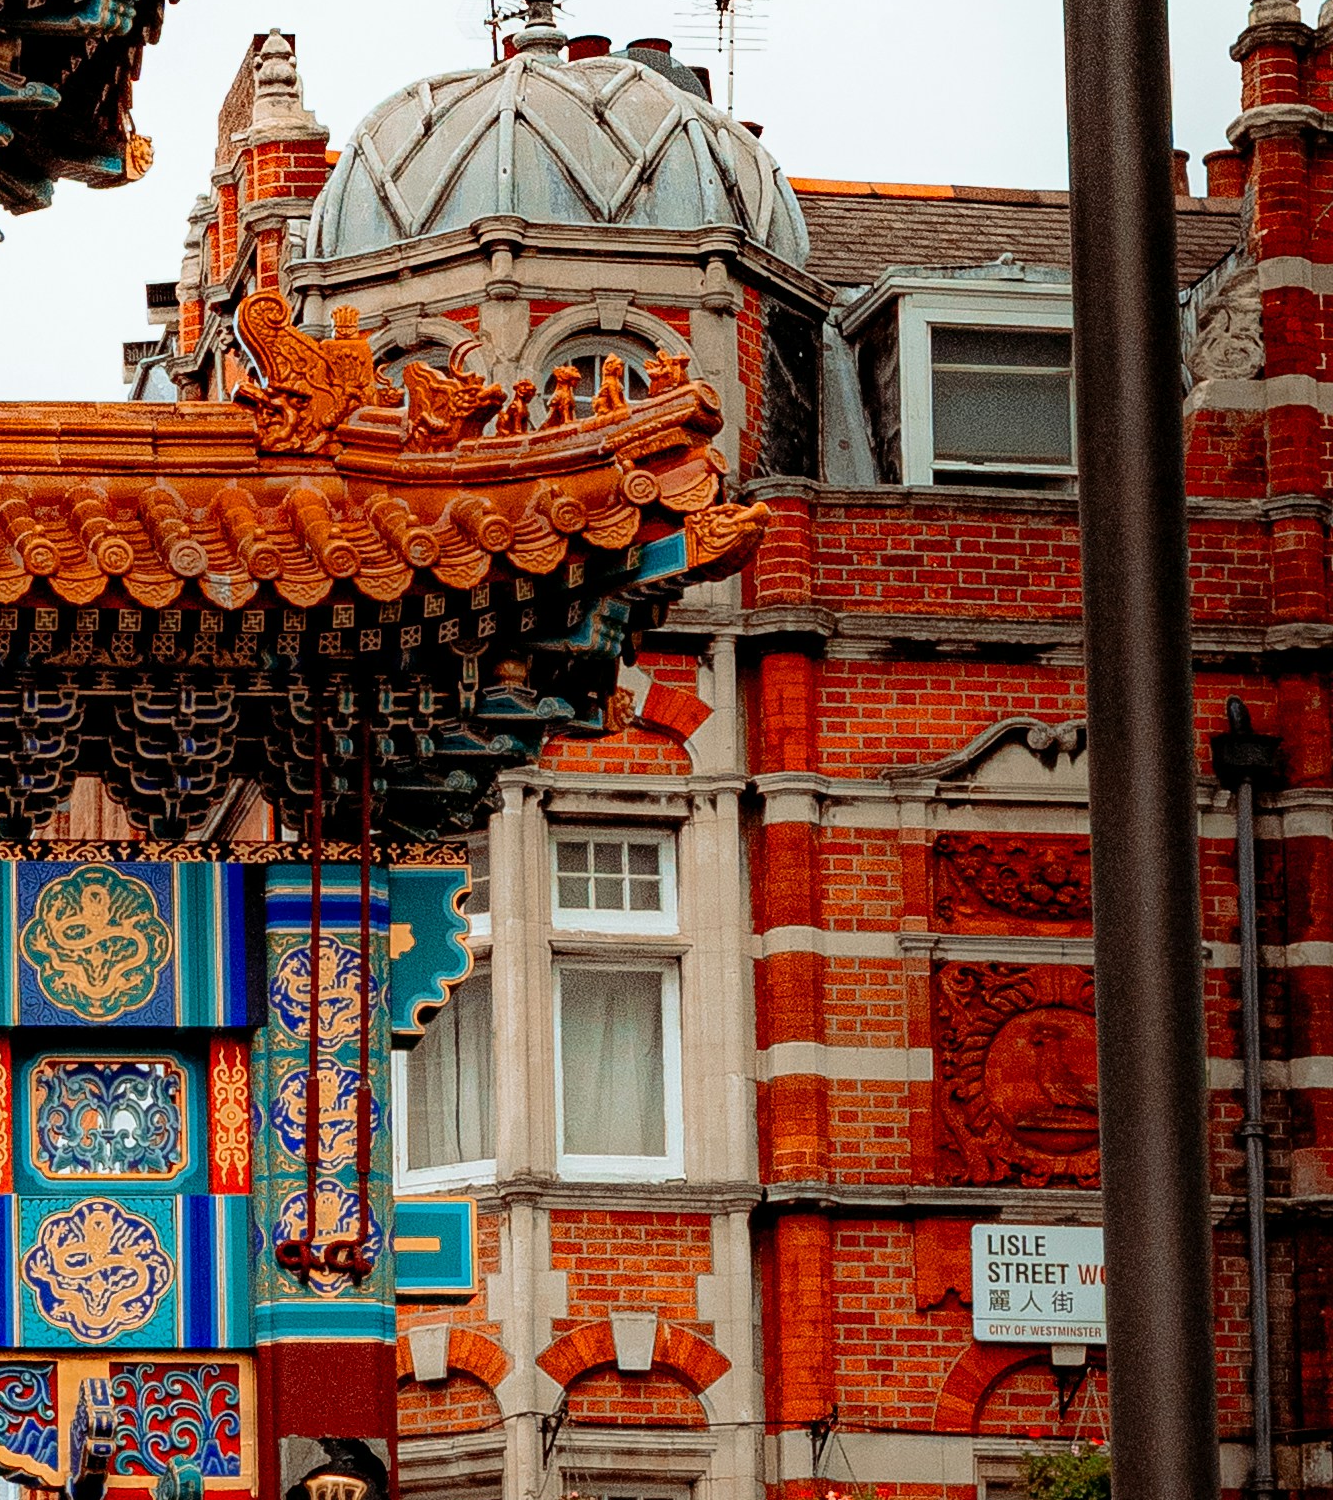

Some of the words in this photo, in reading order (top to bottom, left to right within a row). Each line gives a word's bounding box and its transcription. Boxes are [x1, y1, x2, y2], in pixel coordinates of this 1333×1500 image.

[987, 1235, 1046, 1257] LISLE
[988, 1263, 1069, 1285] STREET
[988, 1289, 1074, 1315] 麗人街
[989, 1324, 1011, 1337] CITY
[1014, 1325, 1027, 1337] OF
[1030, 1326, 1102, 1339] WESTMINSTER
